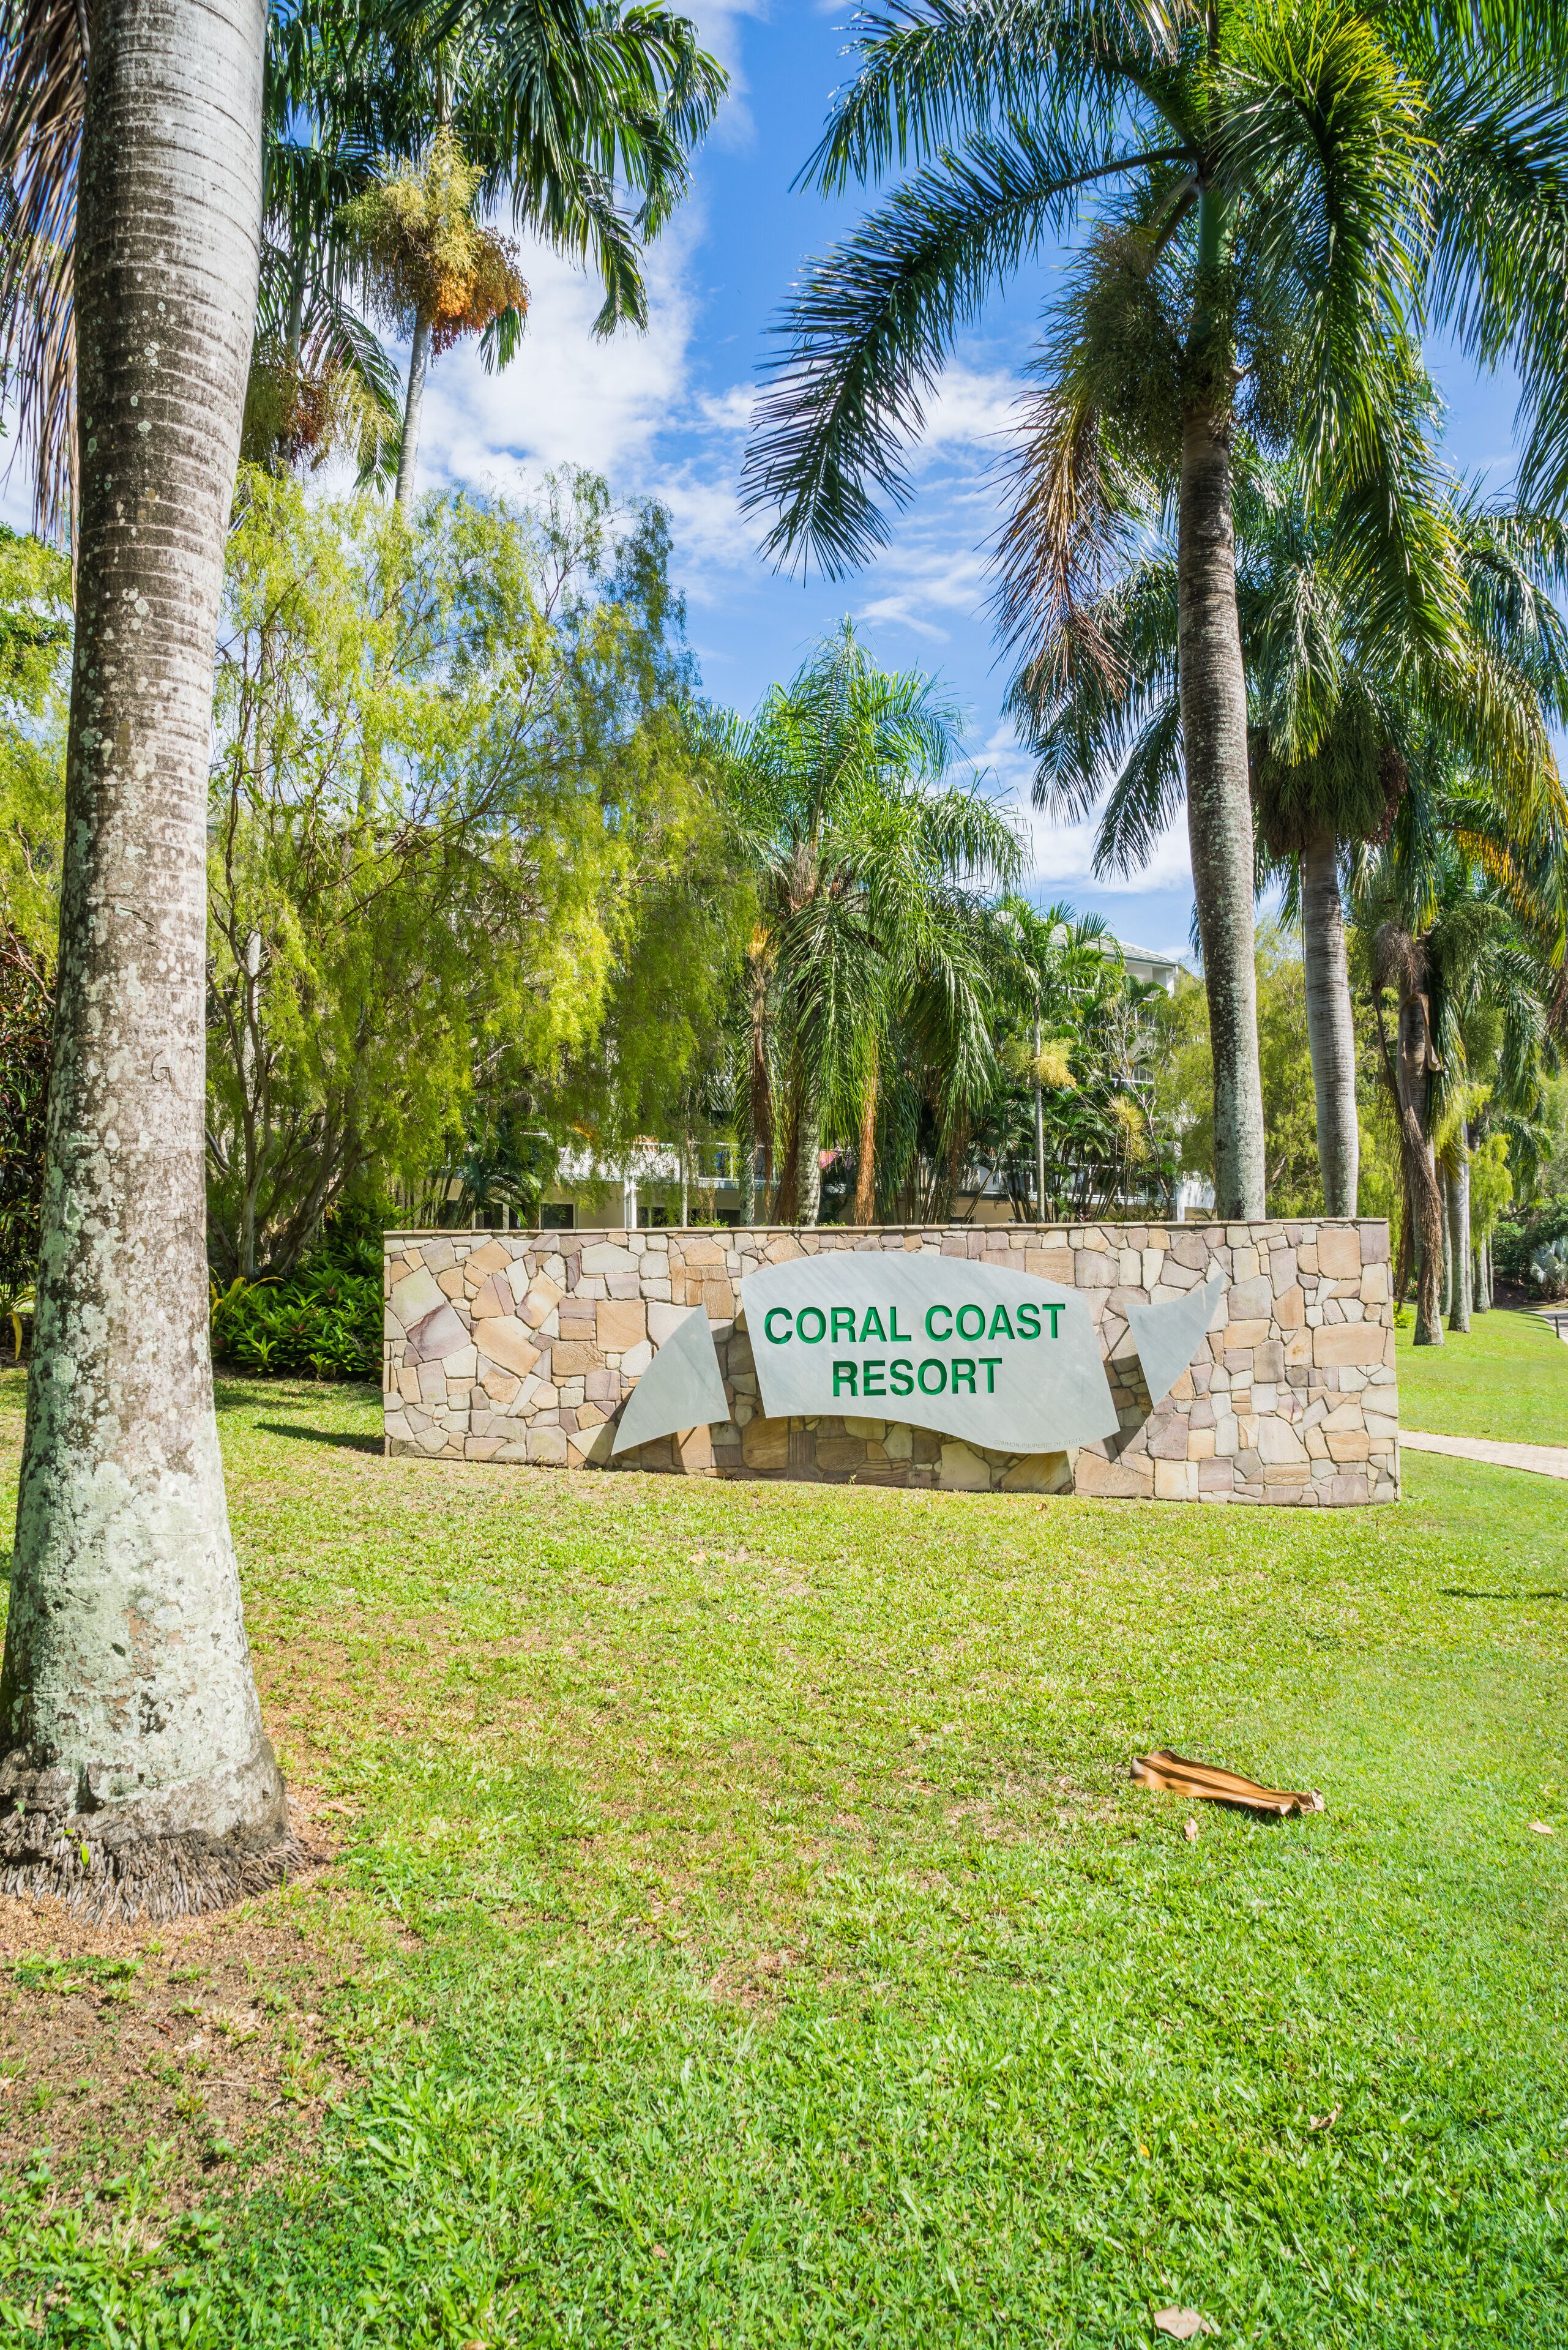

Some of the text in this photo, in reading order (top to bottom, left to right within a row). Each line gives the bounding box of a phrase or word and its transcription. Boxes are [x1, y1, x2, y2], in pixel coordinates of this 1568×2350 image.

[764, 1303, 1066, 1345] CORAL COAST
[832, 1357, 1002, 1397] RESORT
[993, 1439, 1020, 1448] COMMON
